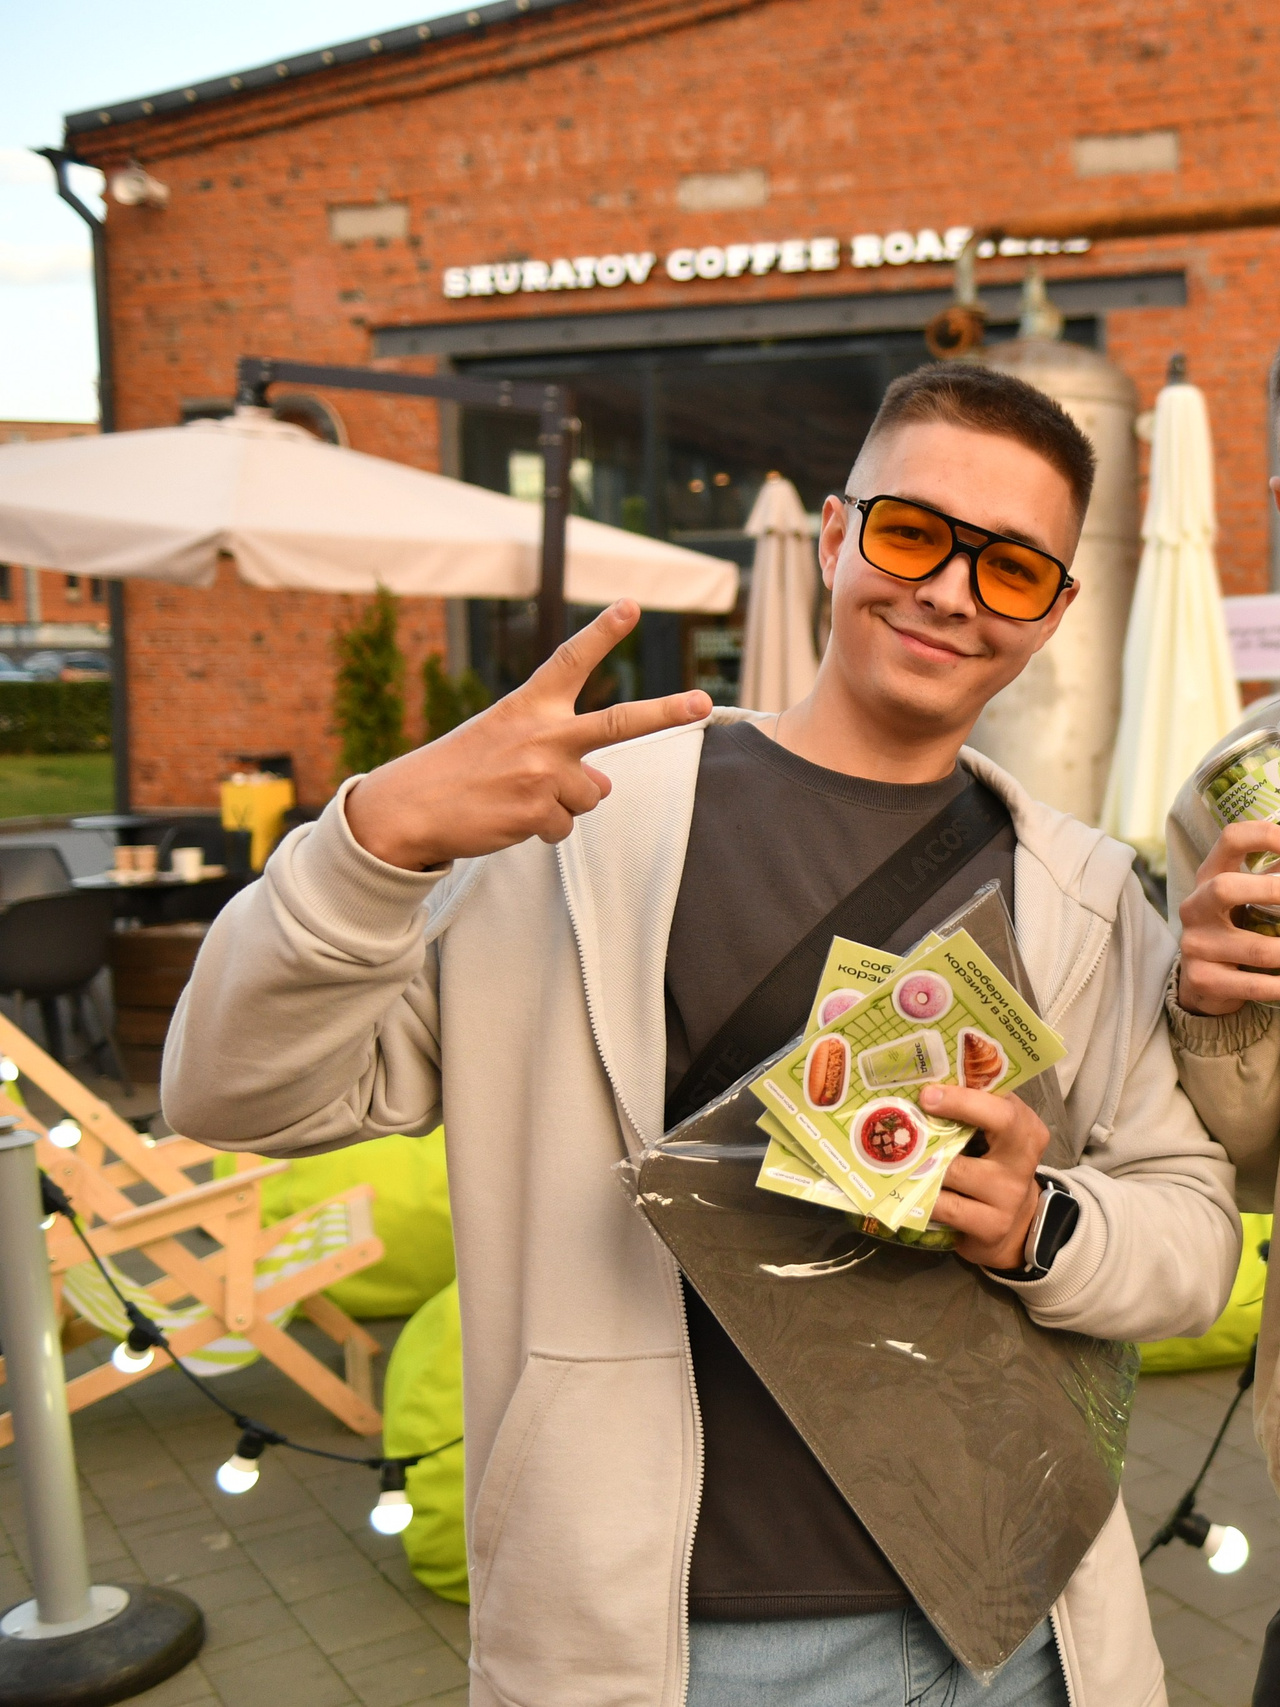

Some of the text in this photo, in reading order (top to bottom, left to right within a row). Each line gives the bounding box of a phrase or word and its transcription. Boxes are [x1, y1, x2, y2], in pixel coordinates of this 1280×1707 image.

[666, 237, 841, 283] COFFEE
[1217, 782, 1248, 811] арахис
[1222, 779, 1268, 817] со вкусом
[1226, 796, 1257, 824] васаби
[860, 959, 895, 974] соб
[944, 952, 1040, 1062] корзину в Заряде
[966, 961, 1038, 1042] собери свою
[914, 1042, 928, 1074] заряд
